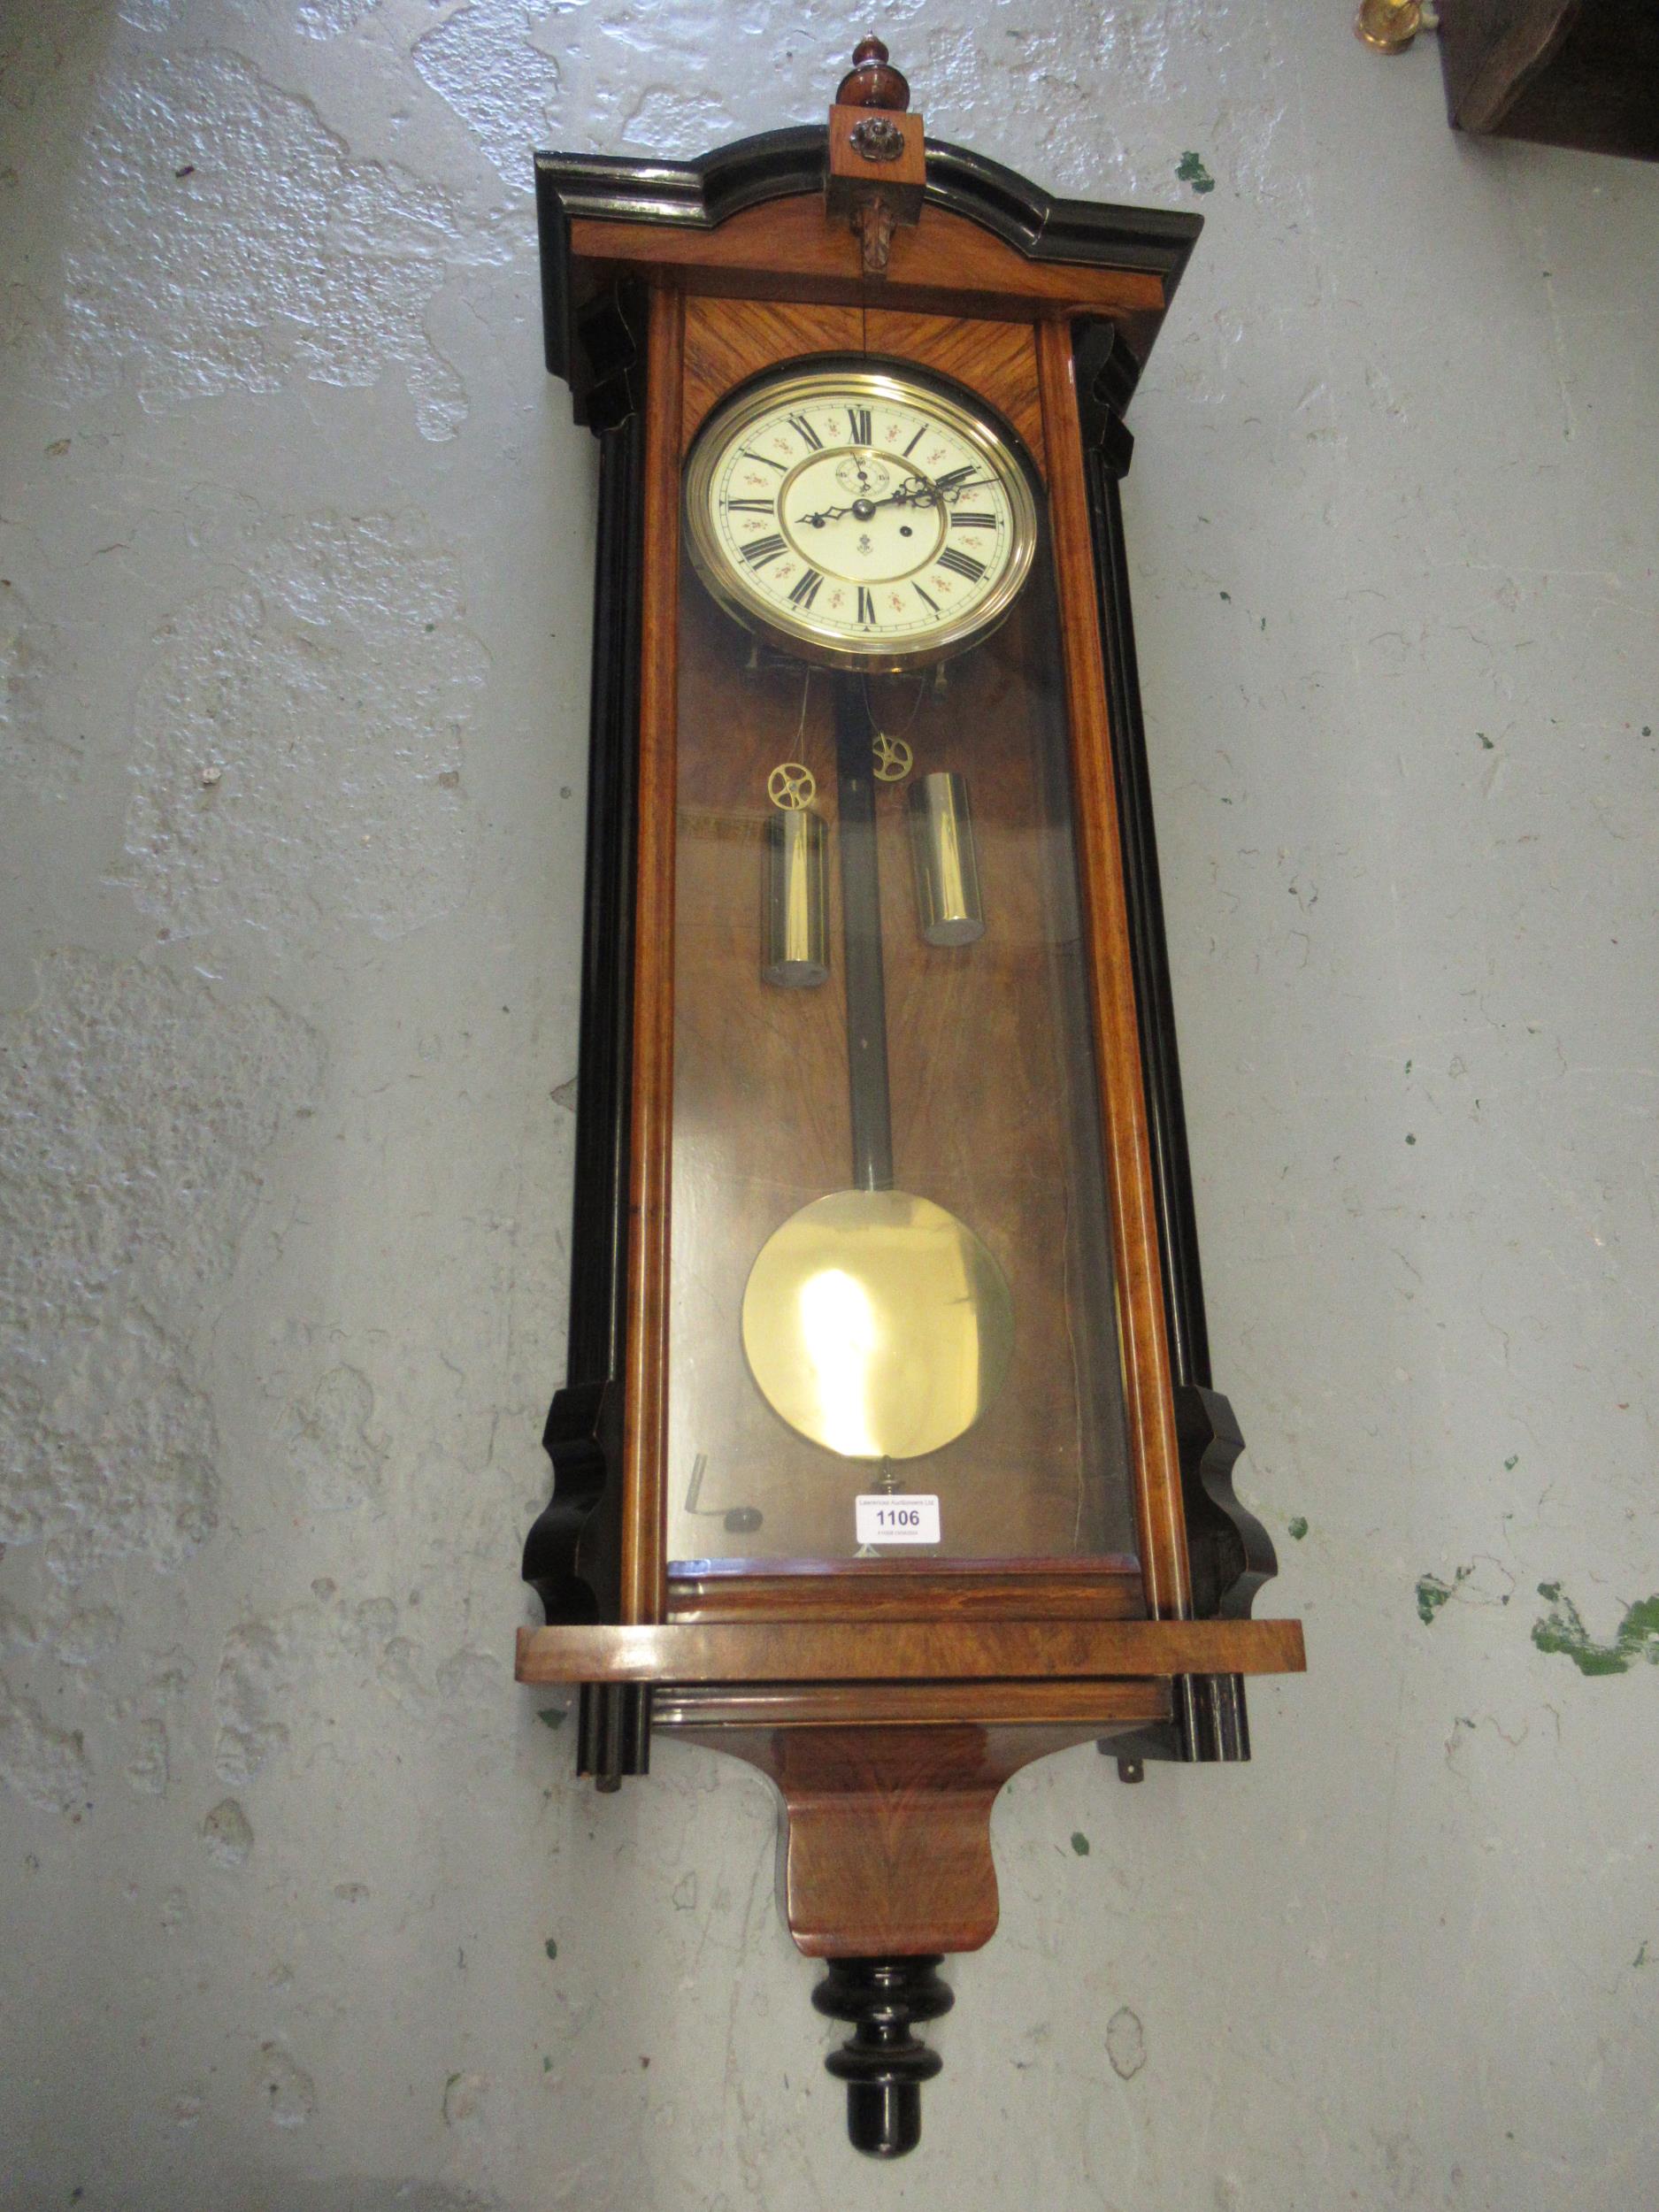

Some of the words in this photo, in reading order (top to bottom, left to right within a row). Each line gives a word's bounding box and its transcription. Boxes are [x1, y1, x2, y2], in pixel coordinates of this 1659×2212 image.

[848, 409, 872, 446] XII
[727, 498, 776, 514] IX
[950, 511, 996, 531] III
[739, 533, 789, 572] VIII
[936, 546, 988, 584] IIII
[787, 569, 824, 611] VII
[856, 586, 876, 625] VI
[877, 1509, 920, 1526] 1106
